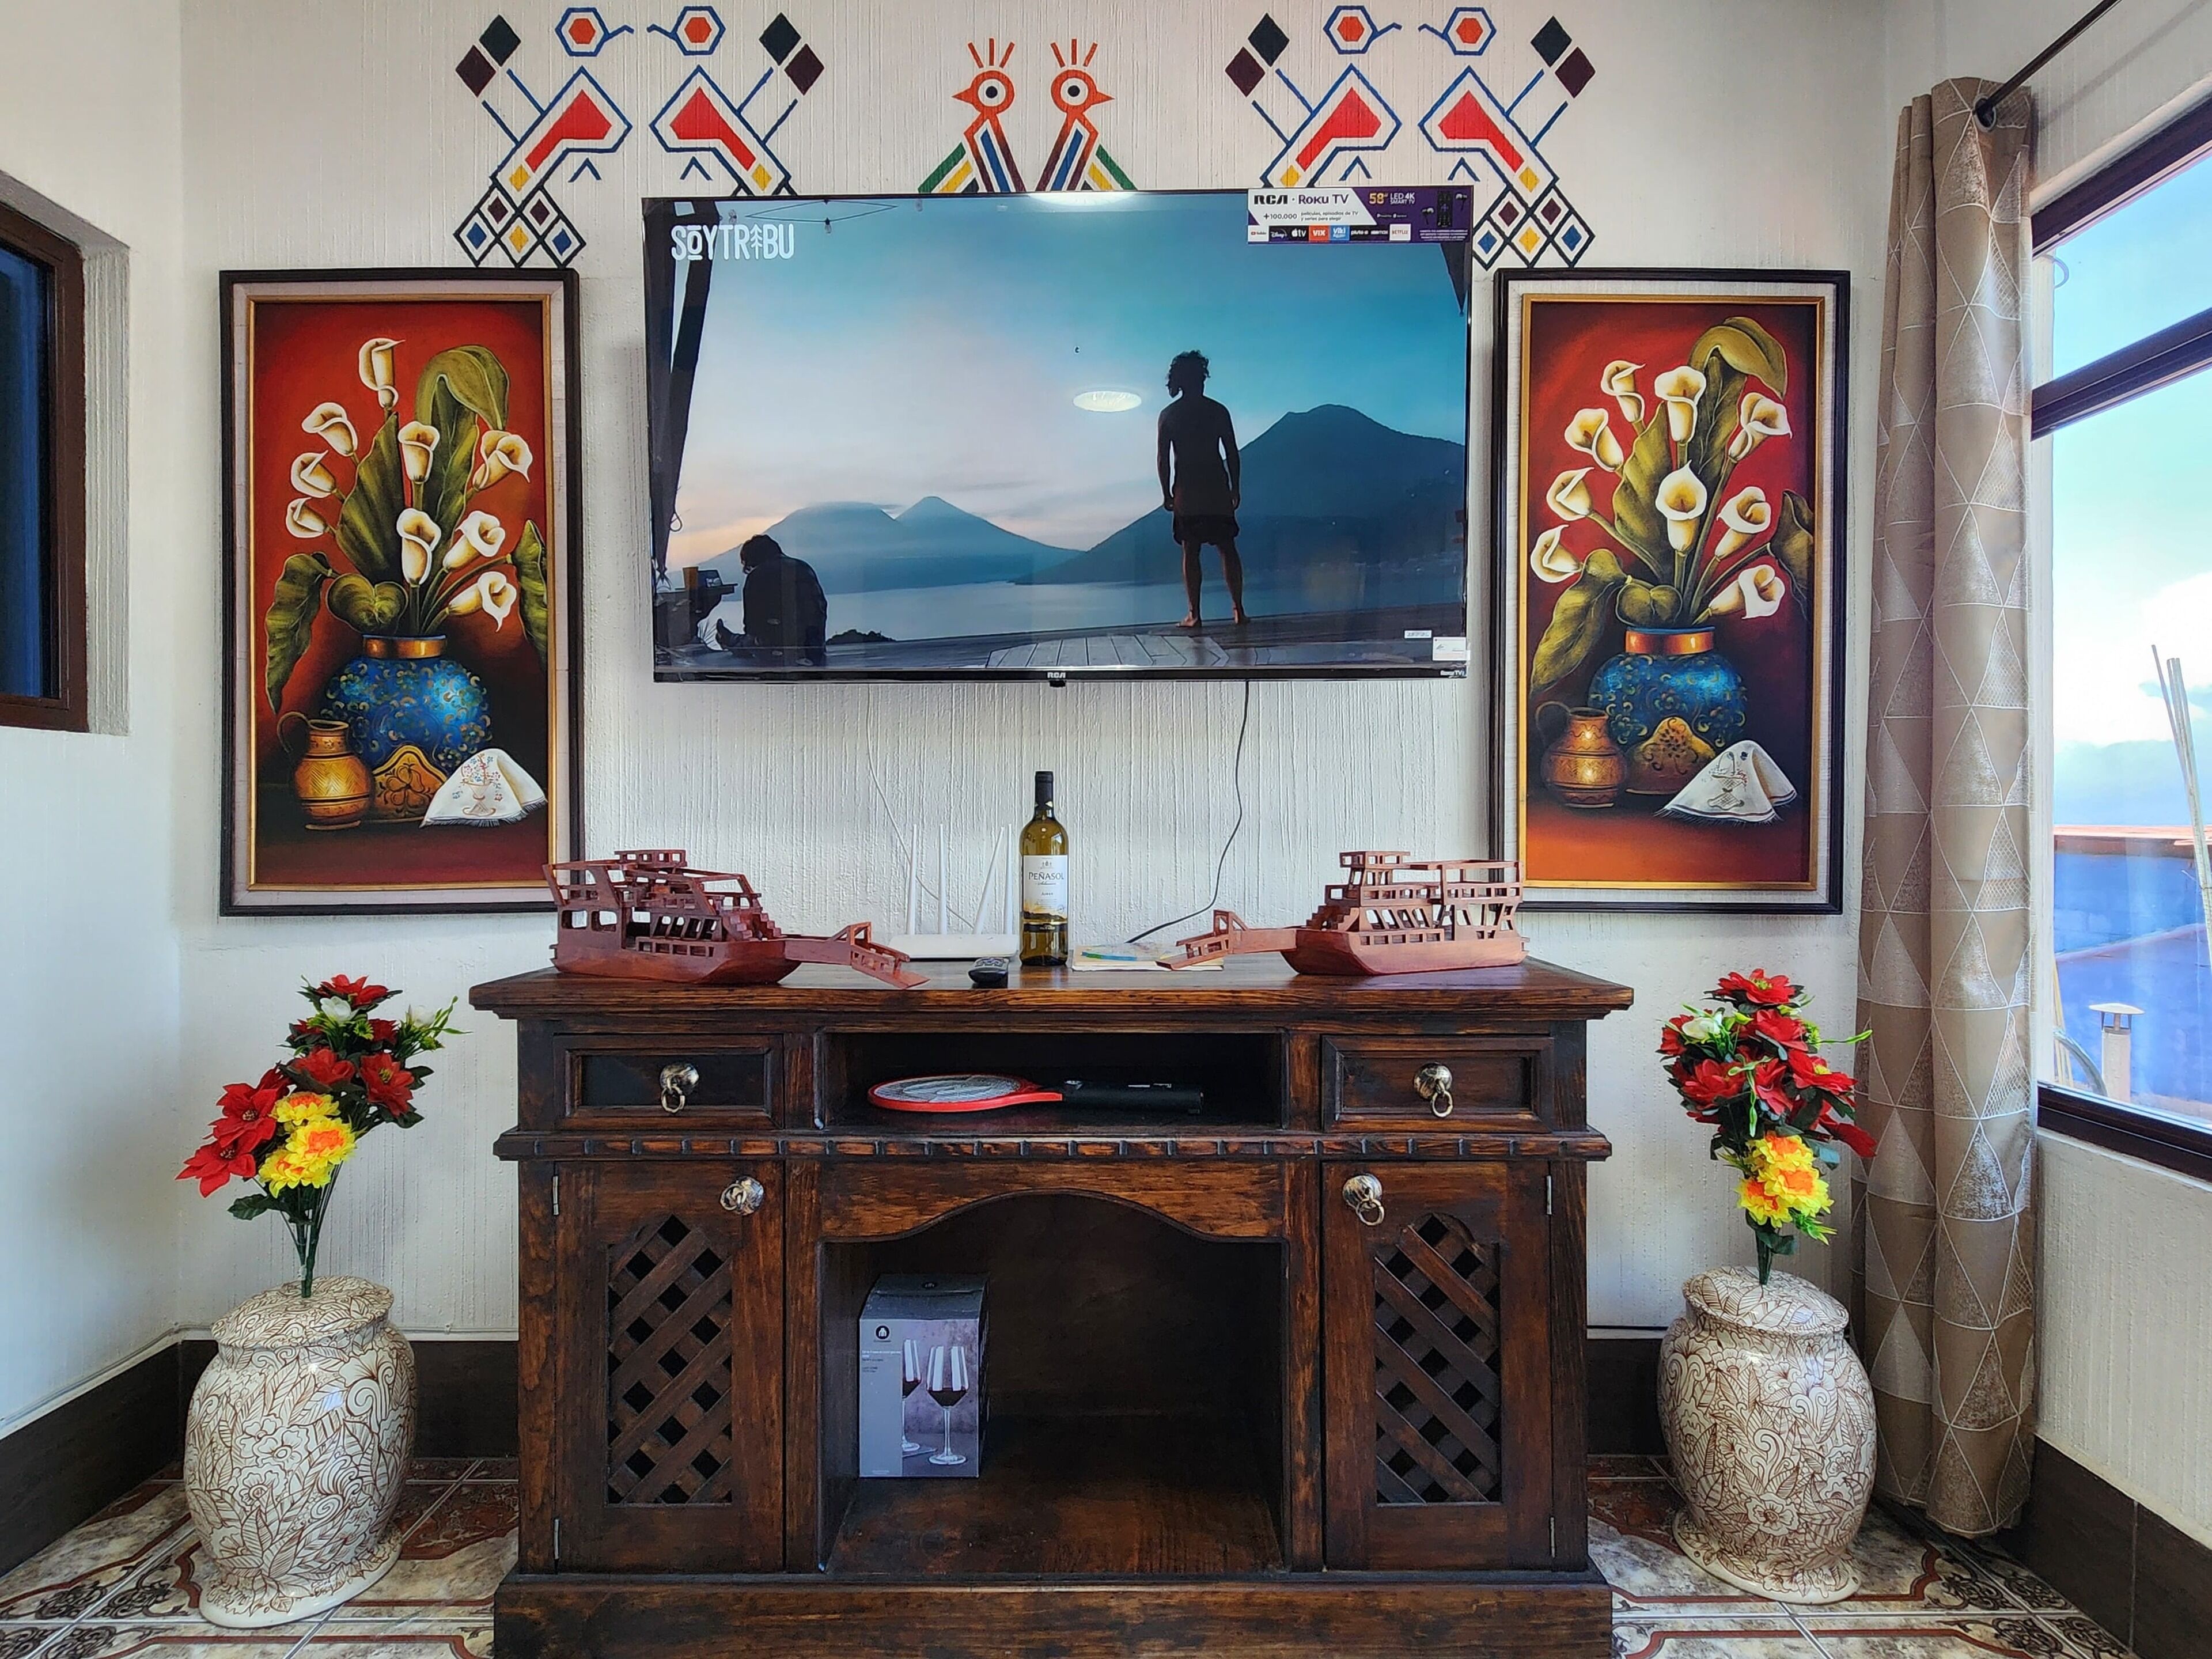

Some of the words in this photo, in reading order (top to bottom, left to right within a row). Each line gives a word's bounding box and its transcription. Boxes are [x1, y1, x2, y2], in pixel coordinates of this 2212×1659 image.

[1254, 195, 1288, 204] RCA
[1298, 194, 1329, 204] Roku
[1332, 194, 1349, 204] TV
[1028, 871, 1064, 880] PEÑASOL
